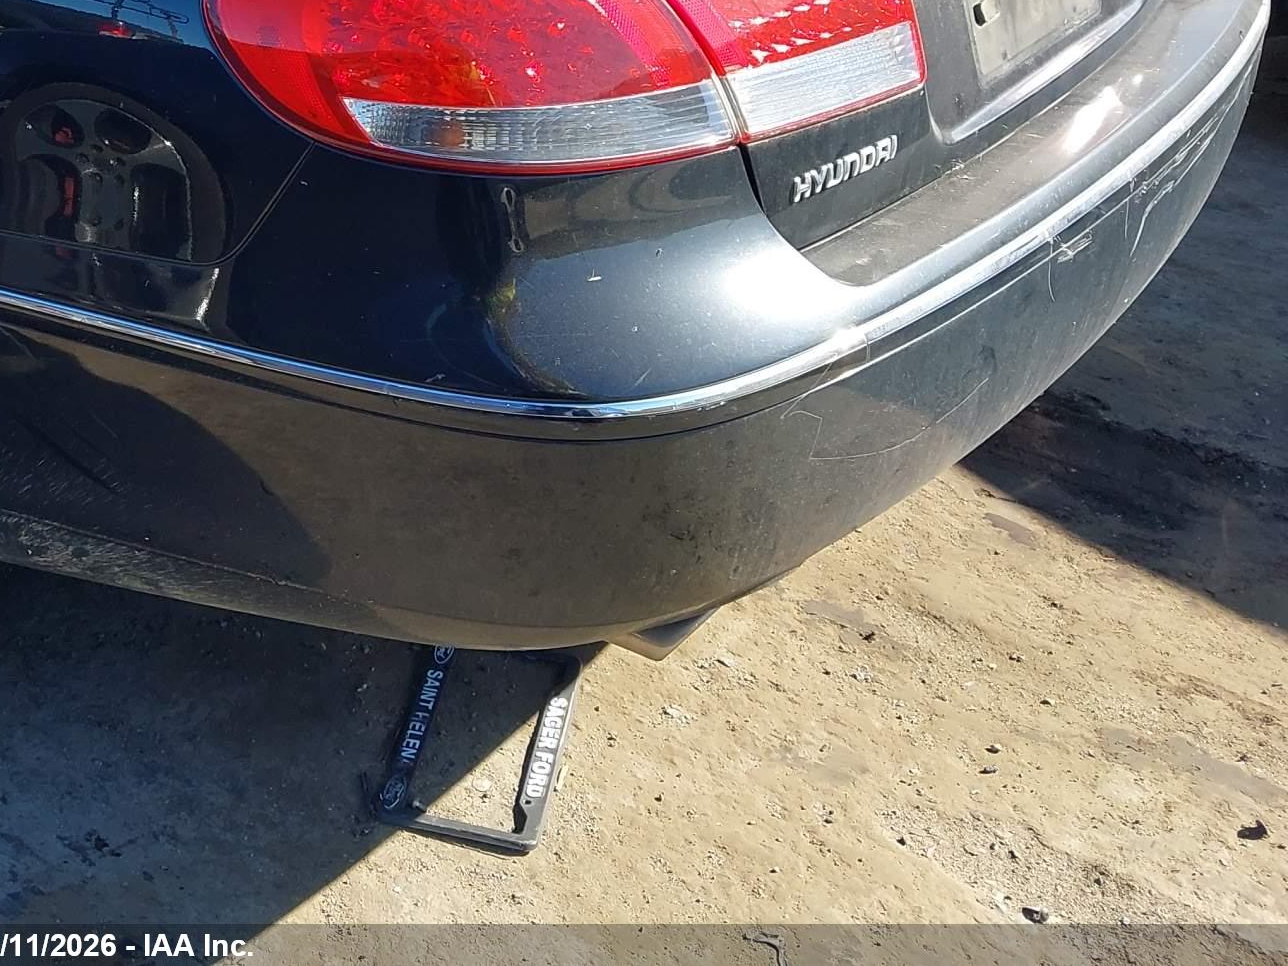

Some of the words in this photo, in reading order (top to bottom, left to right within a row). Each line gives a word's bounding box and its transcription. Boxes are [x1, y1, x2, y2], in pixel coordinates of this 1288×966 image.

[794, 134, 898, 203] HYUNDAI
[418, 669, 444, 710] SAINT
[536, 697, 568, 749] SAGER
[526, 751, 554, 797] FORD
